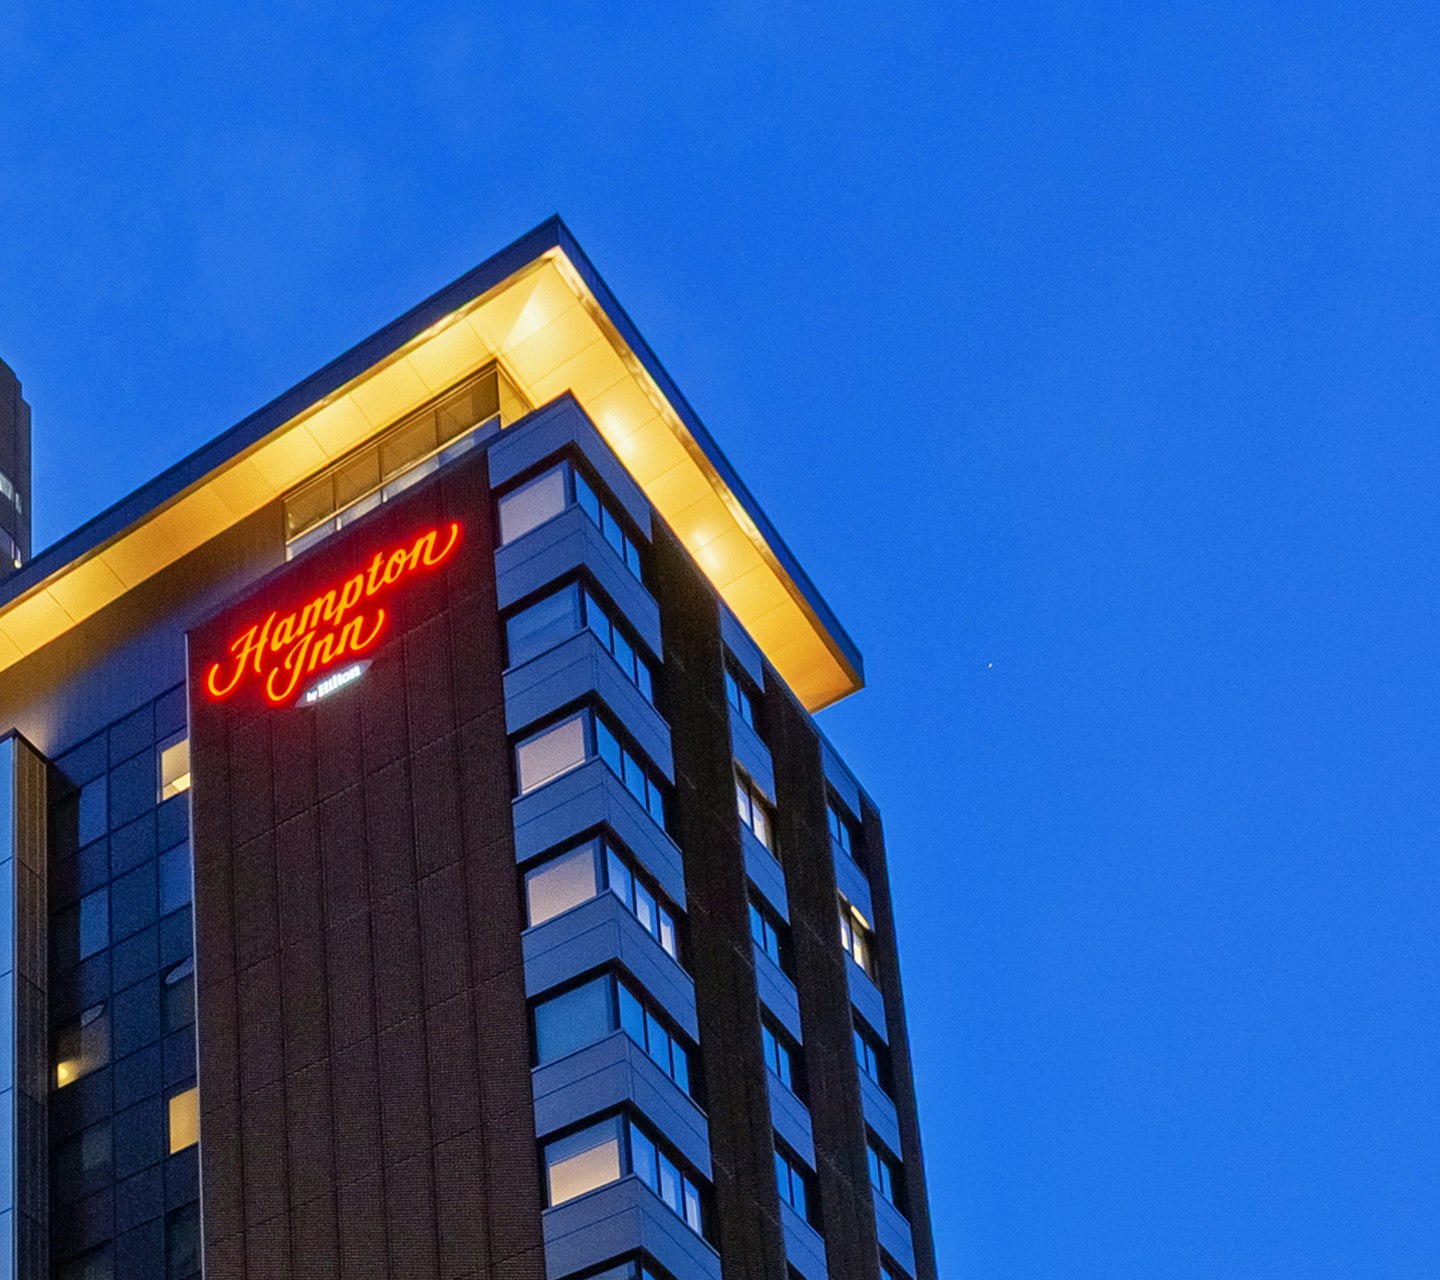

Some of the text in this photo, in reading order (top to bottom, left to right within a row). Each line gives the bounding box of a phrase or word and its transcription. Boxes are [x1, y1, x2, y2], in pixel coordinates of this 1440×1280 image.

[208, 523, 459, 697] Hampton
[266, 608, 386, 701] Inn
[317, 664, 361, 698] Hilton
